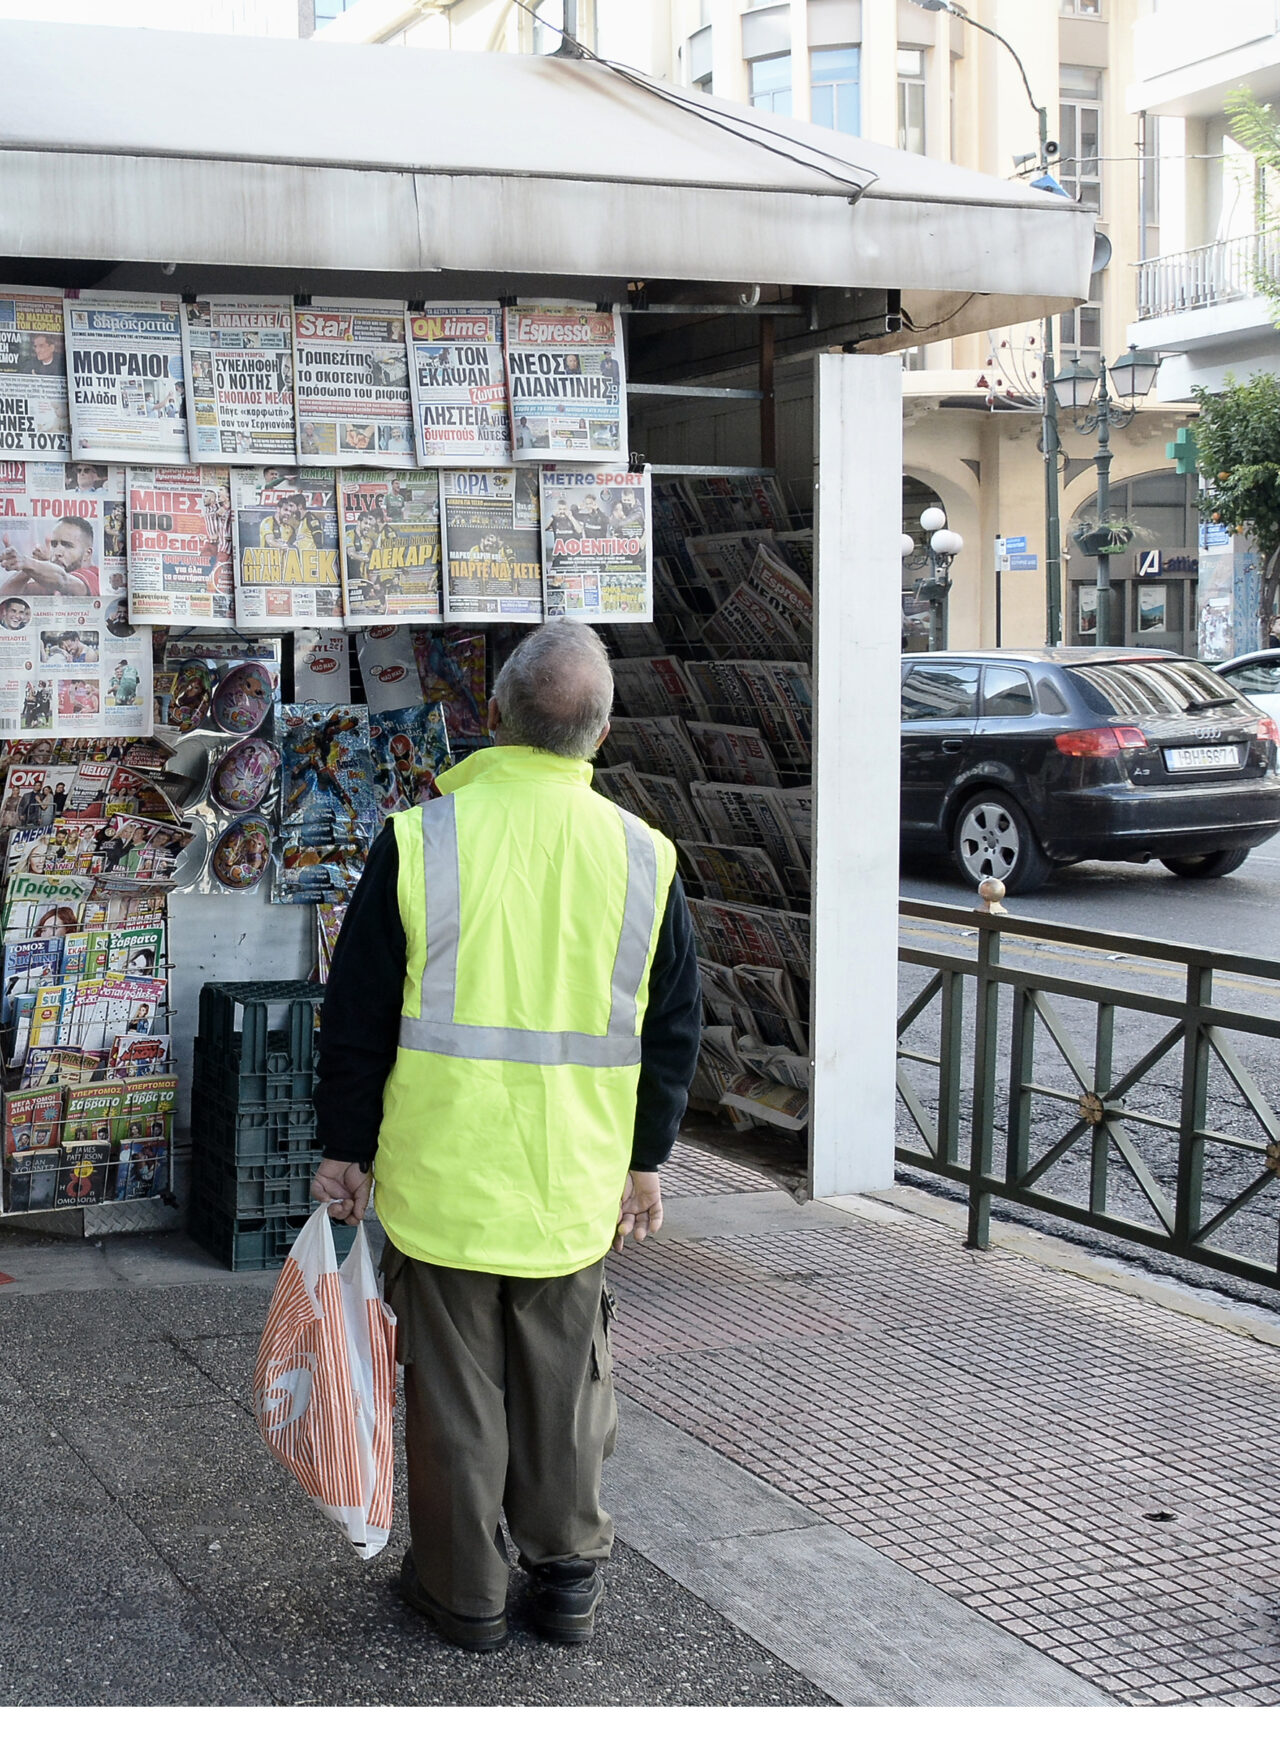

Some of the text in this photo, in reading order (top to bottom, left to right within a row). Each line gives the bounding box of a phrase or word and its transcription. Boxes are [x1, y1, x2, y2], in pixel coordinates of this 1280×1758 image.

[93, 312, 176, 334] δημοκρατία
[299, 313, 349, 337] Star
[413, 316, 444, 342] ON
[444, 317, 487, 336] time
[519, 318, 591, 344] Espresso
[72, 350, 170, 379] ΜΟΙΡΑΙΟΙ
[296, 347, 373, 370] Τραπεζίτης
[454, 346, 489, 366] ΤΟΝ
[508, 352, 566, 375] ΝΕΟΣ
[215, 358, 279, 373] ΣΥΝΕΛΗΦΘΗ
[74, 376, 93, 389] για
[96, 376, 116, 389] την
[217, 373, 273, 391] Ο ΝΟΤΗΣ
[297, 370, 373, 385] το σκοτεινό
[418, 367, 491, 387] ΕΚΑΨΑΝ
[74, 390, 117, 405] Ελλάδα
[218, 391, 279, 405] ΕΝΟΠΛΟΣ ΜΕ
[298, 384, 409, 401] πρόσωπο του ριφιφ
[219, 405, 239, 417] Πήγε
[423, 406, 490, 426] ΛΗΣΤΕΙΑ
[221, 419, 250, 429] σαν τον
[456, 473, 489, 495] ΩΡΑ
[542, 472, 644, 485] METROSPORT
[30, 498, 99, 519] ΤΡΟΜΟΣ
[129, 489, 204, 514] ΜΠΕΣ
[132, 512, 174, 532] ΠΙΟ
[130, 531, 199, 552] βαθειά
[552, 538, 641, 556] ΑΦΕΝΤΙΚΟ
[243, 547, 280, 565] ΑΥΤΗ
[174, 566, 186, 574] για
[243, 565, 281, 583] ΗΤΑΝ
[283, 548, 338, 584] ΑΕΚ
[10, 771, 45, 787] OK!
[80, 764, 112, 777] HELLO!
[1133, 767, 1151, 776] A3
[16, 877, 84, 899] Γρίφος
[9, 942, 45, 953] ΤΟΜΟΣ
[109, 934, 158, 949] Σάββατο
[72, 1086, 121, 1098] ΥΠΕΡΤΟΜΟΣ
[127, 1080, 177, 1092] ΥΠΕΡΤΟΜΟΣ
[10, 1094, 56, 1109] ΜΕΓΑ ΤΟΜΟΙ
[69, 1096, 120, 1111] Σάββατο
